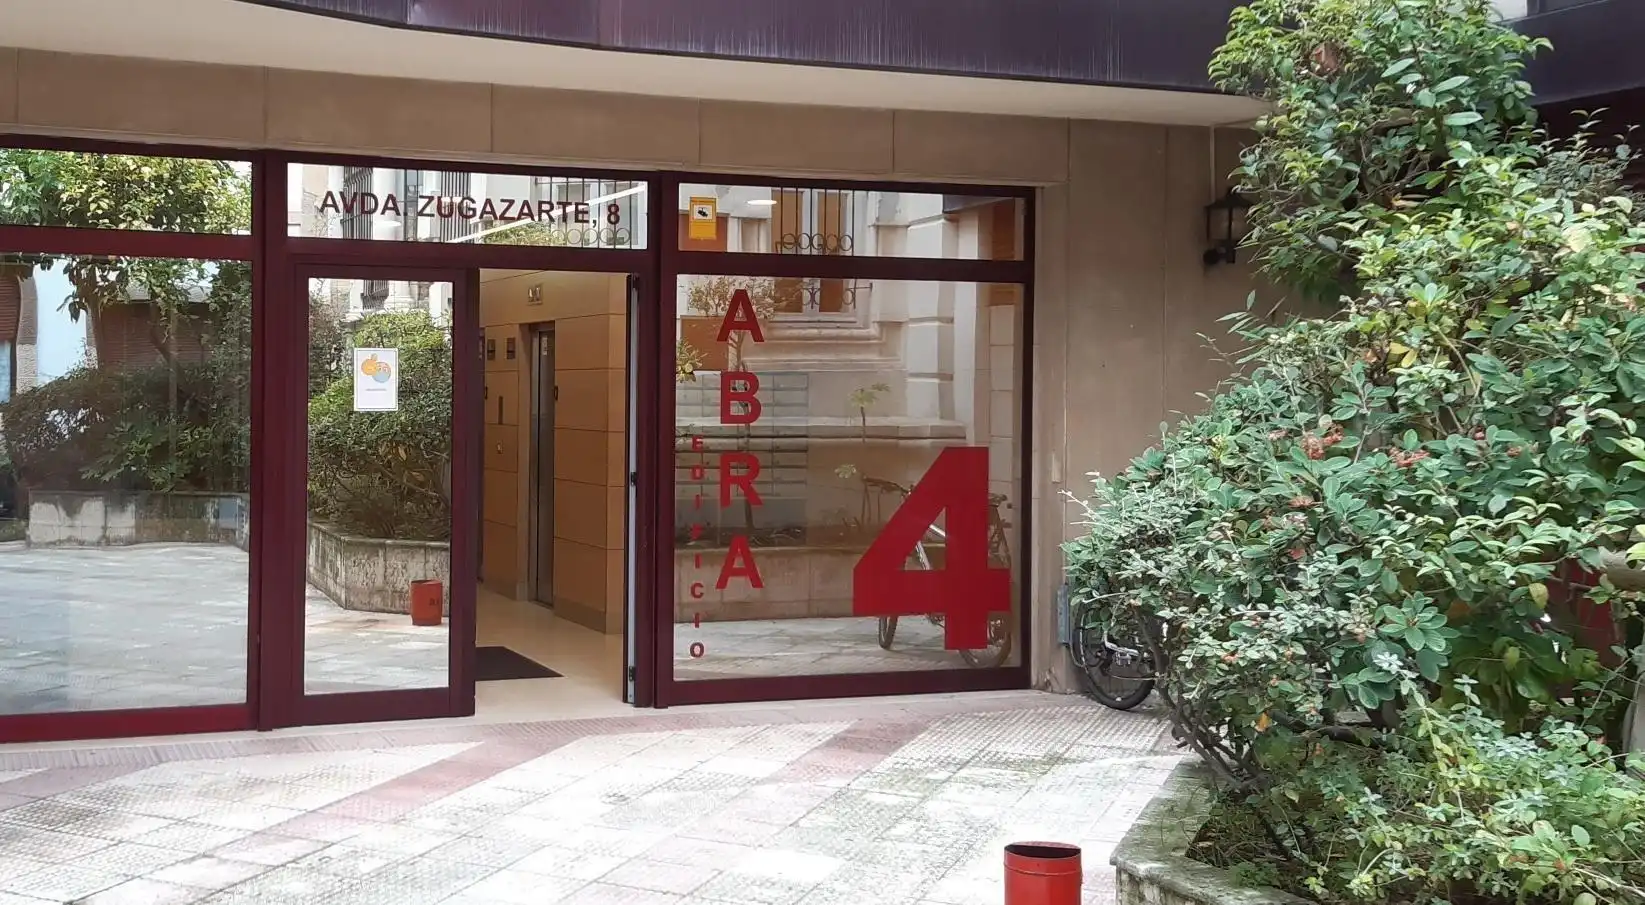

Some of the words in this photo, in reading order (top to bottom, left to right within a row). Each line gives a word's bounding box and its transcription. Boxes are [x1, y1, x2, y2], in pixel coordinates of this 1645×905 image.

[320, 190, 408, 217] AVDA.
[417, 195, 597, 229] ZUGAZARTE,
[606, 203, 621, 226] 8
[716, 288, 764, 589] ABRA
[689, 434, 705, 658] EDIFICIO
[852, 446, 1011, 650] 4
